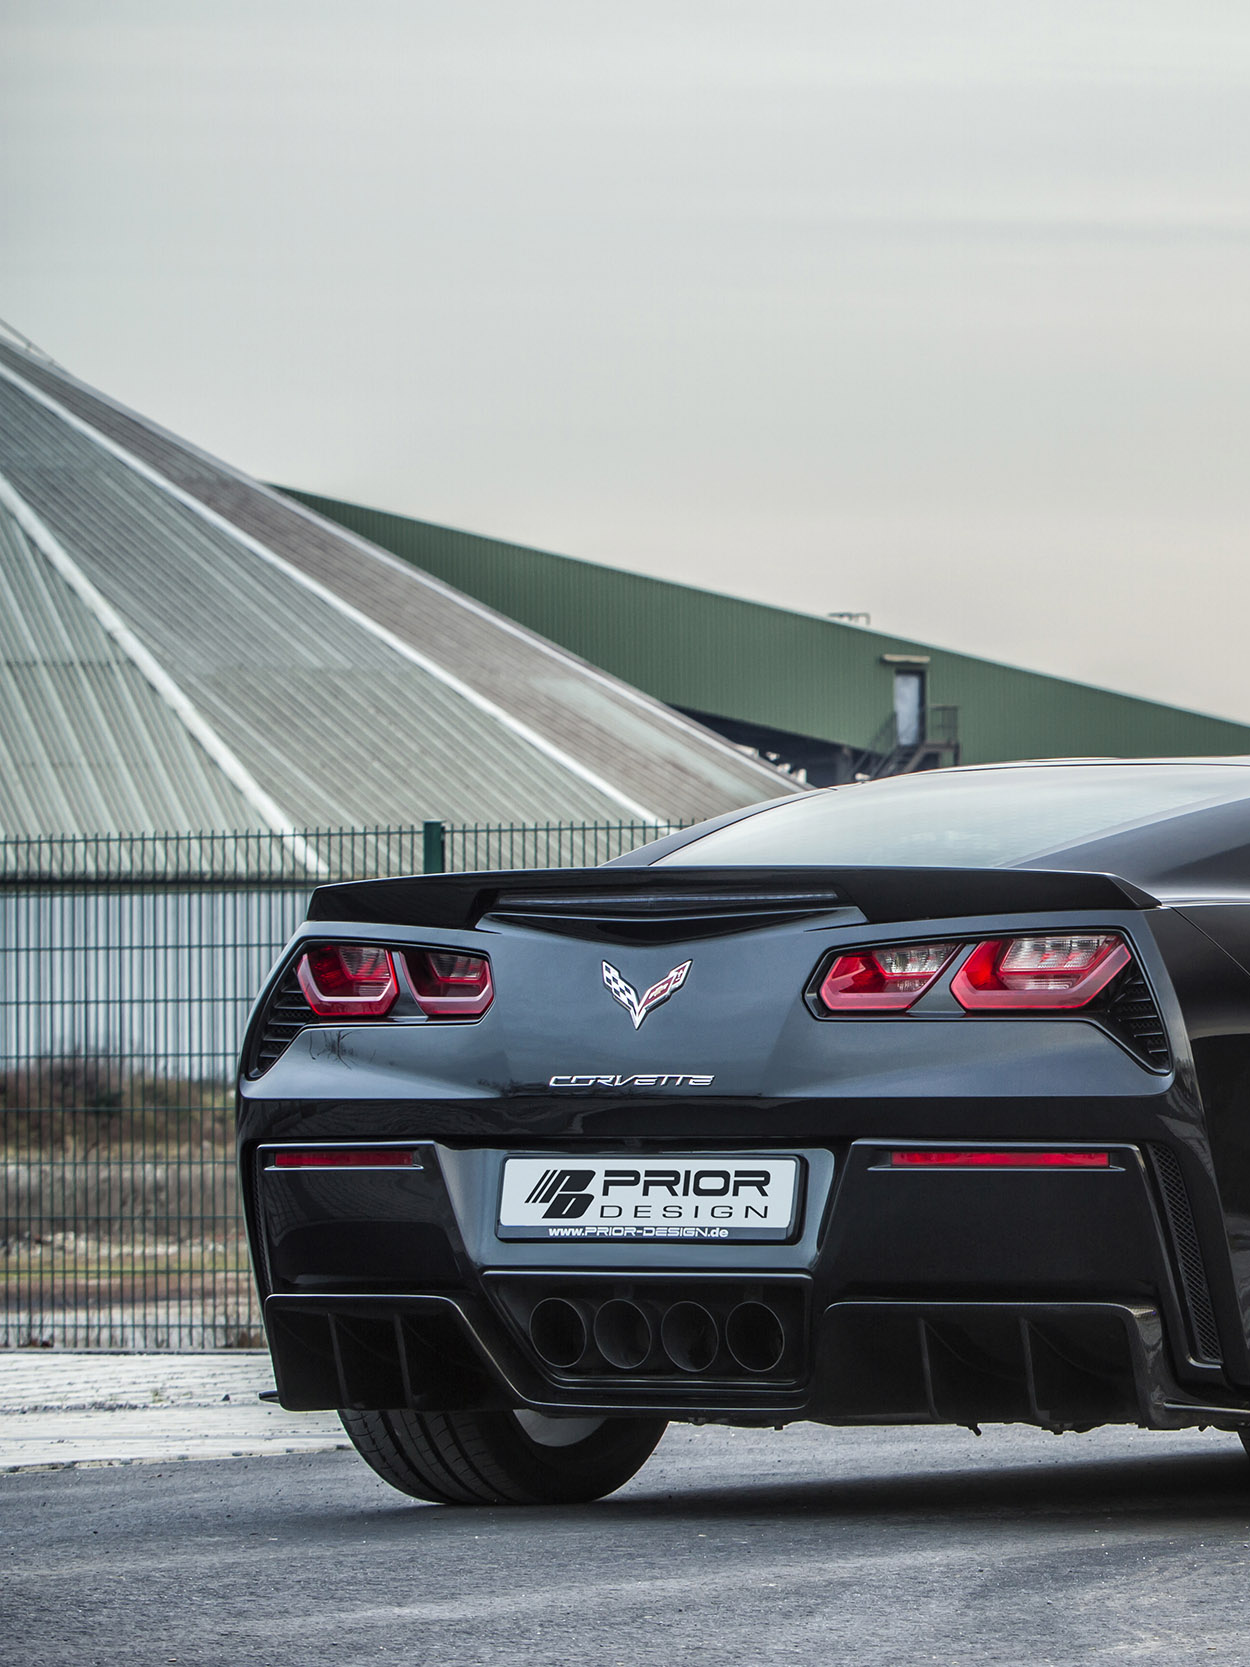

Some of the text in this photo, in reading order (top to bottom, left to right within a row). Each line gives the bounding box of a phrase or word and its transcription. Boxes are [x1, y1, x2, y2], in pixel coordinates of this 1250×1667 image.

[550, 1075, 714, 1087] CORVETTE
[602, 1170, 771, 1197] PRIOR
[600, 1205, 768, 1219] DESIGN
[549, 1226, 728, 1238] www.PRIOR-DESIGN.de
